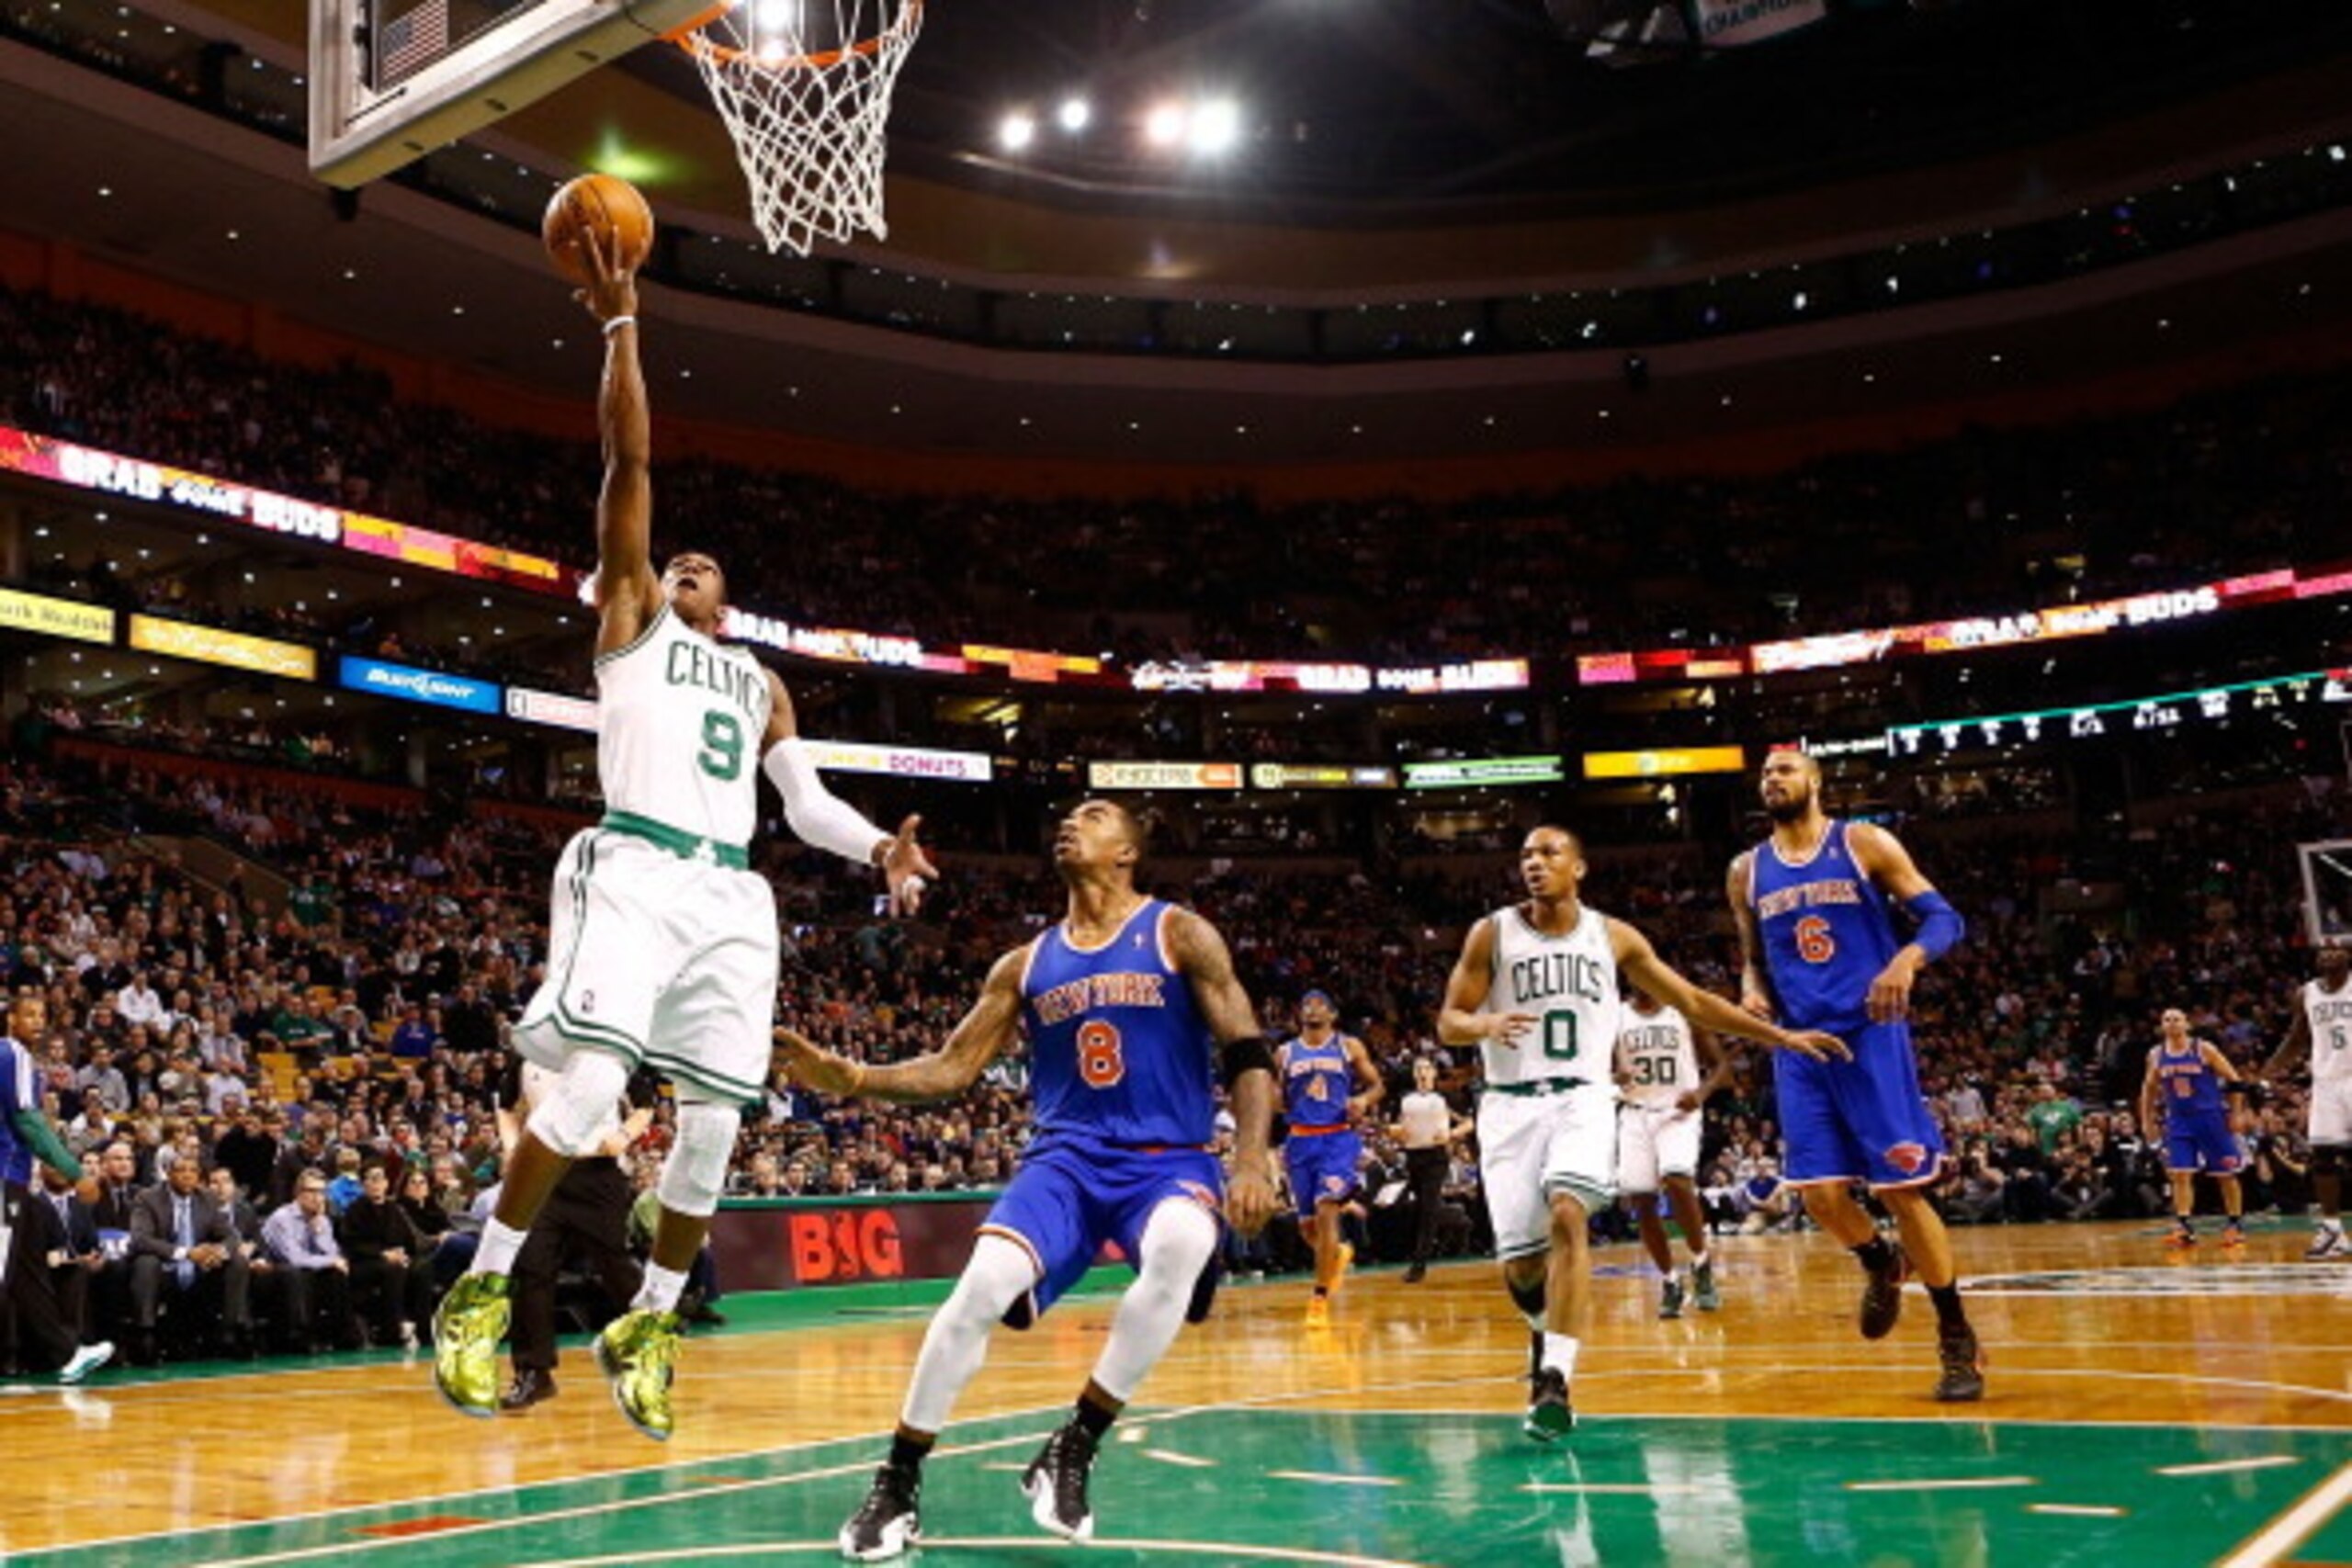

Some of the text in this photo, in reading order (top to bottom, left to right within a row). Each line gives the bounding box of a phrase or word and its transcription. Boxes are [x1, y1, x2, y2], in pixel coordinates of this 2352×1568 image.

[2125, 588, 2218, 626] BUDS
[697, 709, 744, 782] 9
[889, 754, 967, 776] DONUTS
[1794, 914, 1835, 964] 6
[1511, 953, 1601, 1004] CELTICS
[1077, 1019, 1125, 1090] 8
[1544, 1010, 1577, 1061] 0
[1624, 1024, 1680, 1054] CELTICS
[1306, 1073, 1329, 1101] 4
[1634, 1056, 1676, 1086] 30
